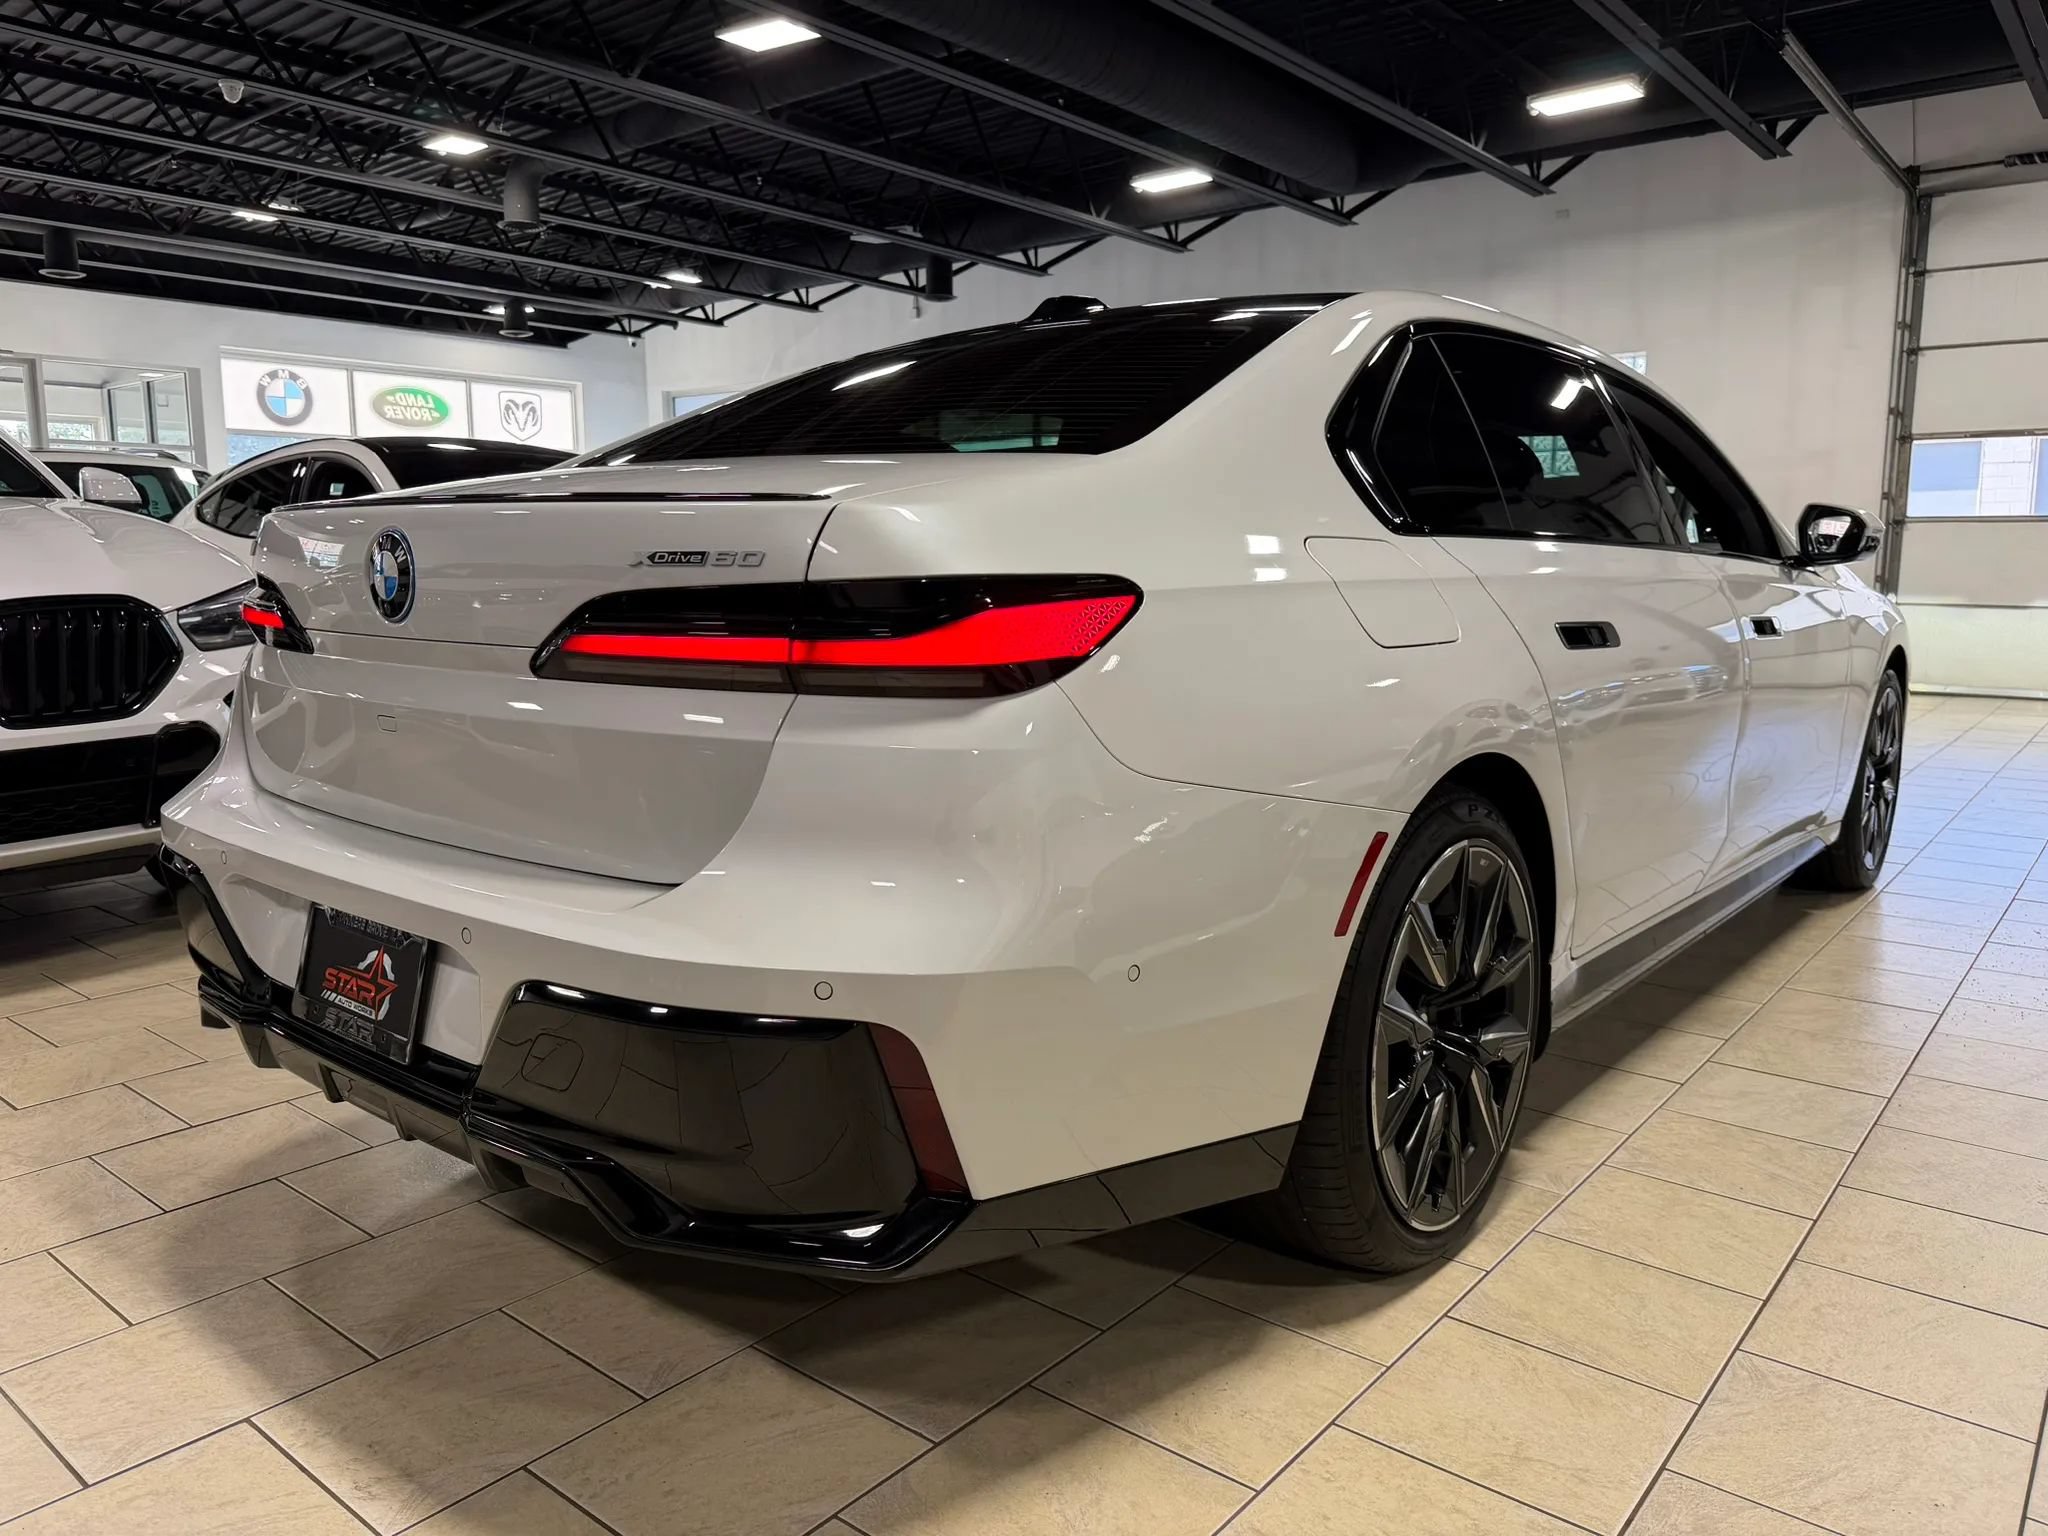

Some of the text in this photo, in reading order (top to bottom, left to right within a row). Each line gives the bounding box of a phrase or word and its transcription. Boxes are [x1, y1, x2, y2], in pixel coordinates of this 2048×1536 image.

[711, 551, 766, 567] 60
[322, 967, 376, 1007] STAR
[338, 997, 353, 1009] AUTO
[324, 1007, 375, 1043] STAR
